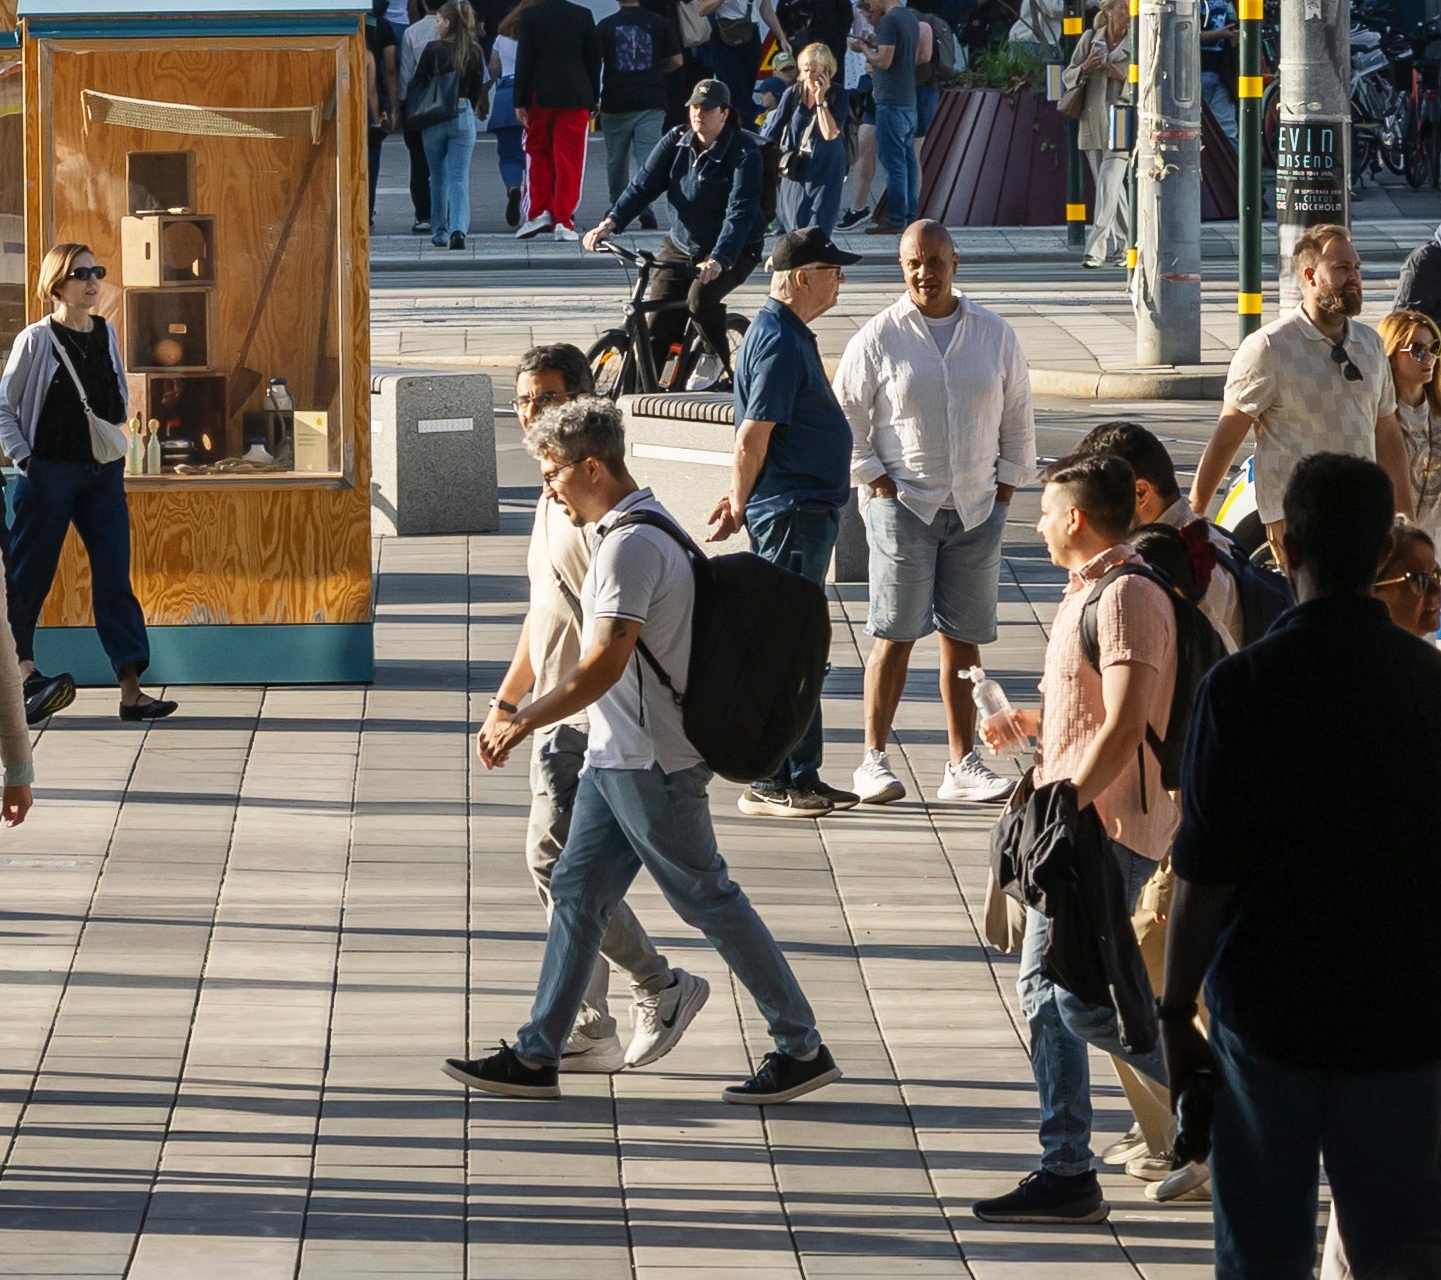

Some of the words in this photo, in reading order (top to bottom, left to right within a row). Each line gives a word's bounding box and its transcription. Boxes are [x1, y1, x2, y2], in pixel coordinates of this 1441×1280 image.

[1279, 126, 1333, 153] EVIN
[1278, 153, 1333, 169] WNSEND
[1294, 202, 1342, 211] STOCKHOLM
